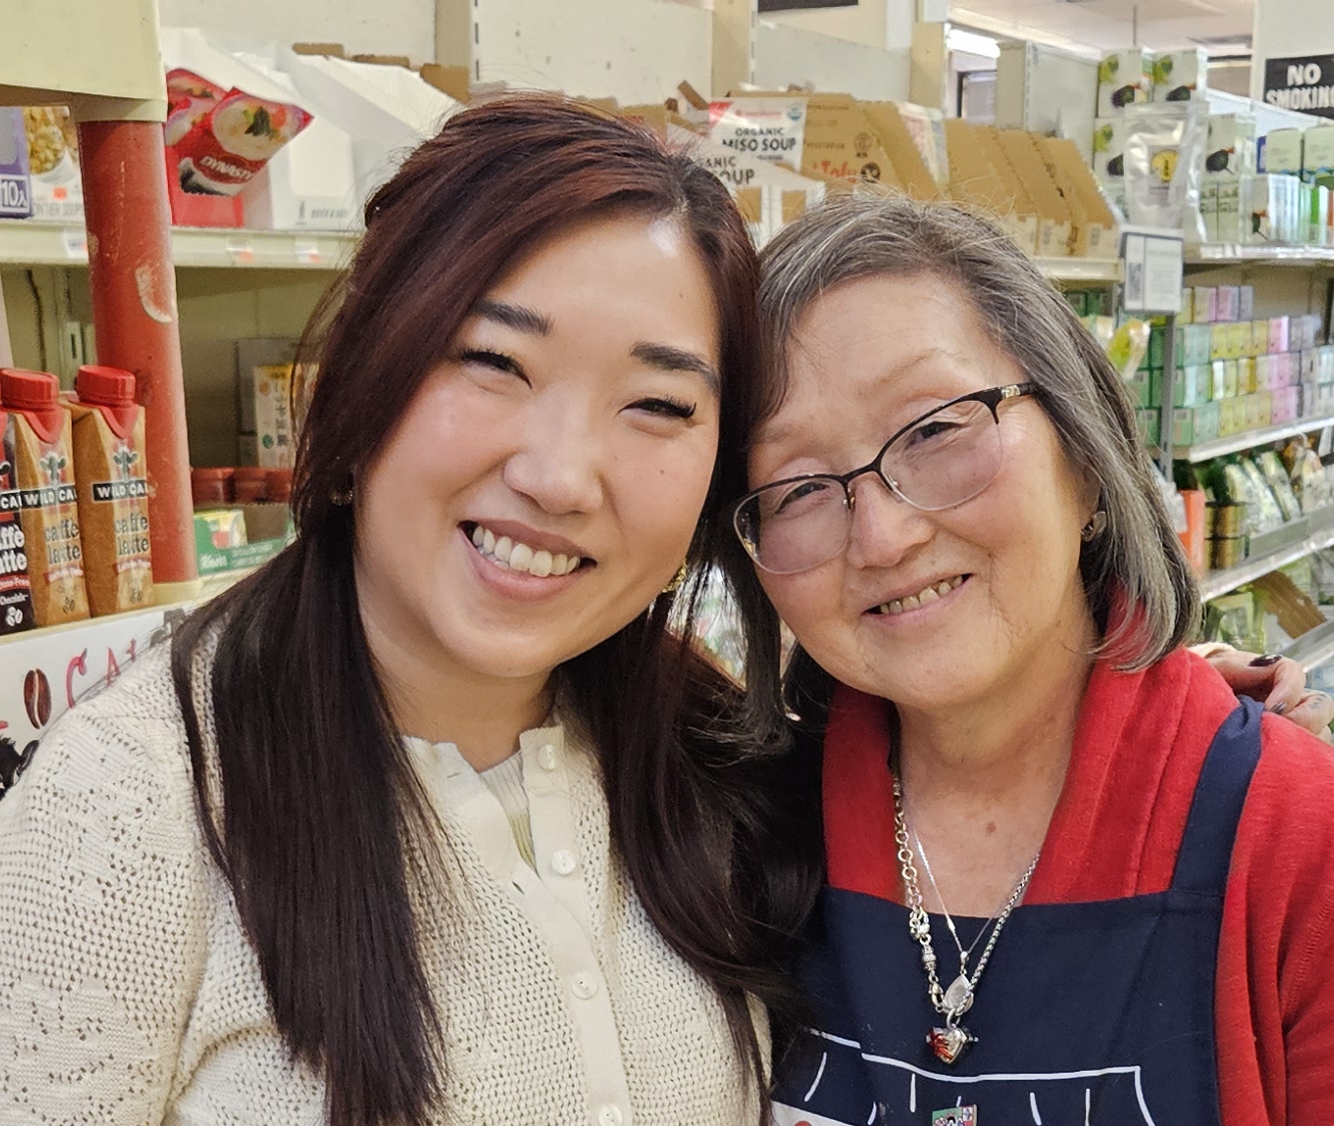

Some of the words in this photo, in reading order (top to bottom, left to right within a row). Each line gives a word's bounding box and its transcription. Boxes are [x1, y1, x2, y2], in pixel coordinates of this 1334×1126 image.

[1286, 62, 1322, 86] NO
[734, 127, 785, 137] ORGANIC
[722, 137, 759, 152] MISO
[762, 137, 797, 151] SOUP
[197, 154, 257, 181] DYNASTY
[720, 168, 755, 186] OUP
[31, 201, 60, 217] ONTIER
[24, 491, 55, 505] WILD
[96, 485, 126, 499] WILD
[48, 543, 81, 565] latte
[118, 536, 149, 557] latte
